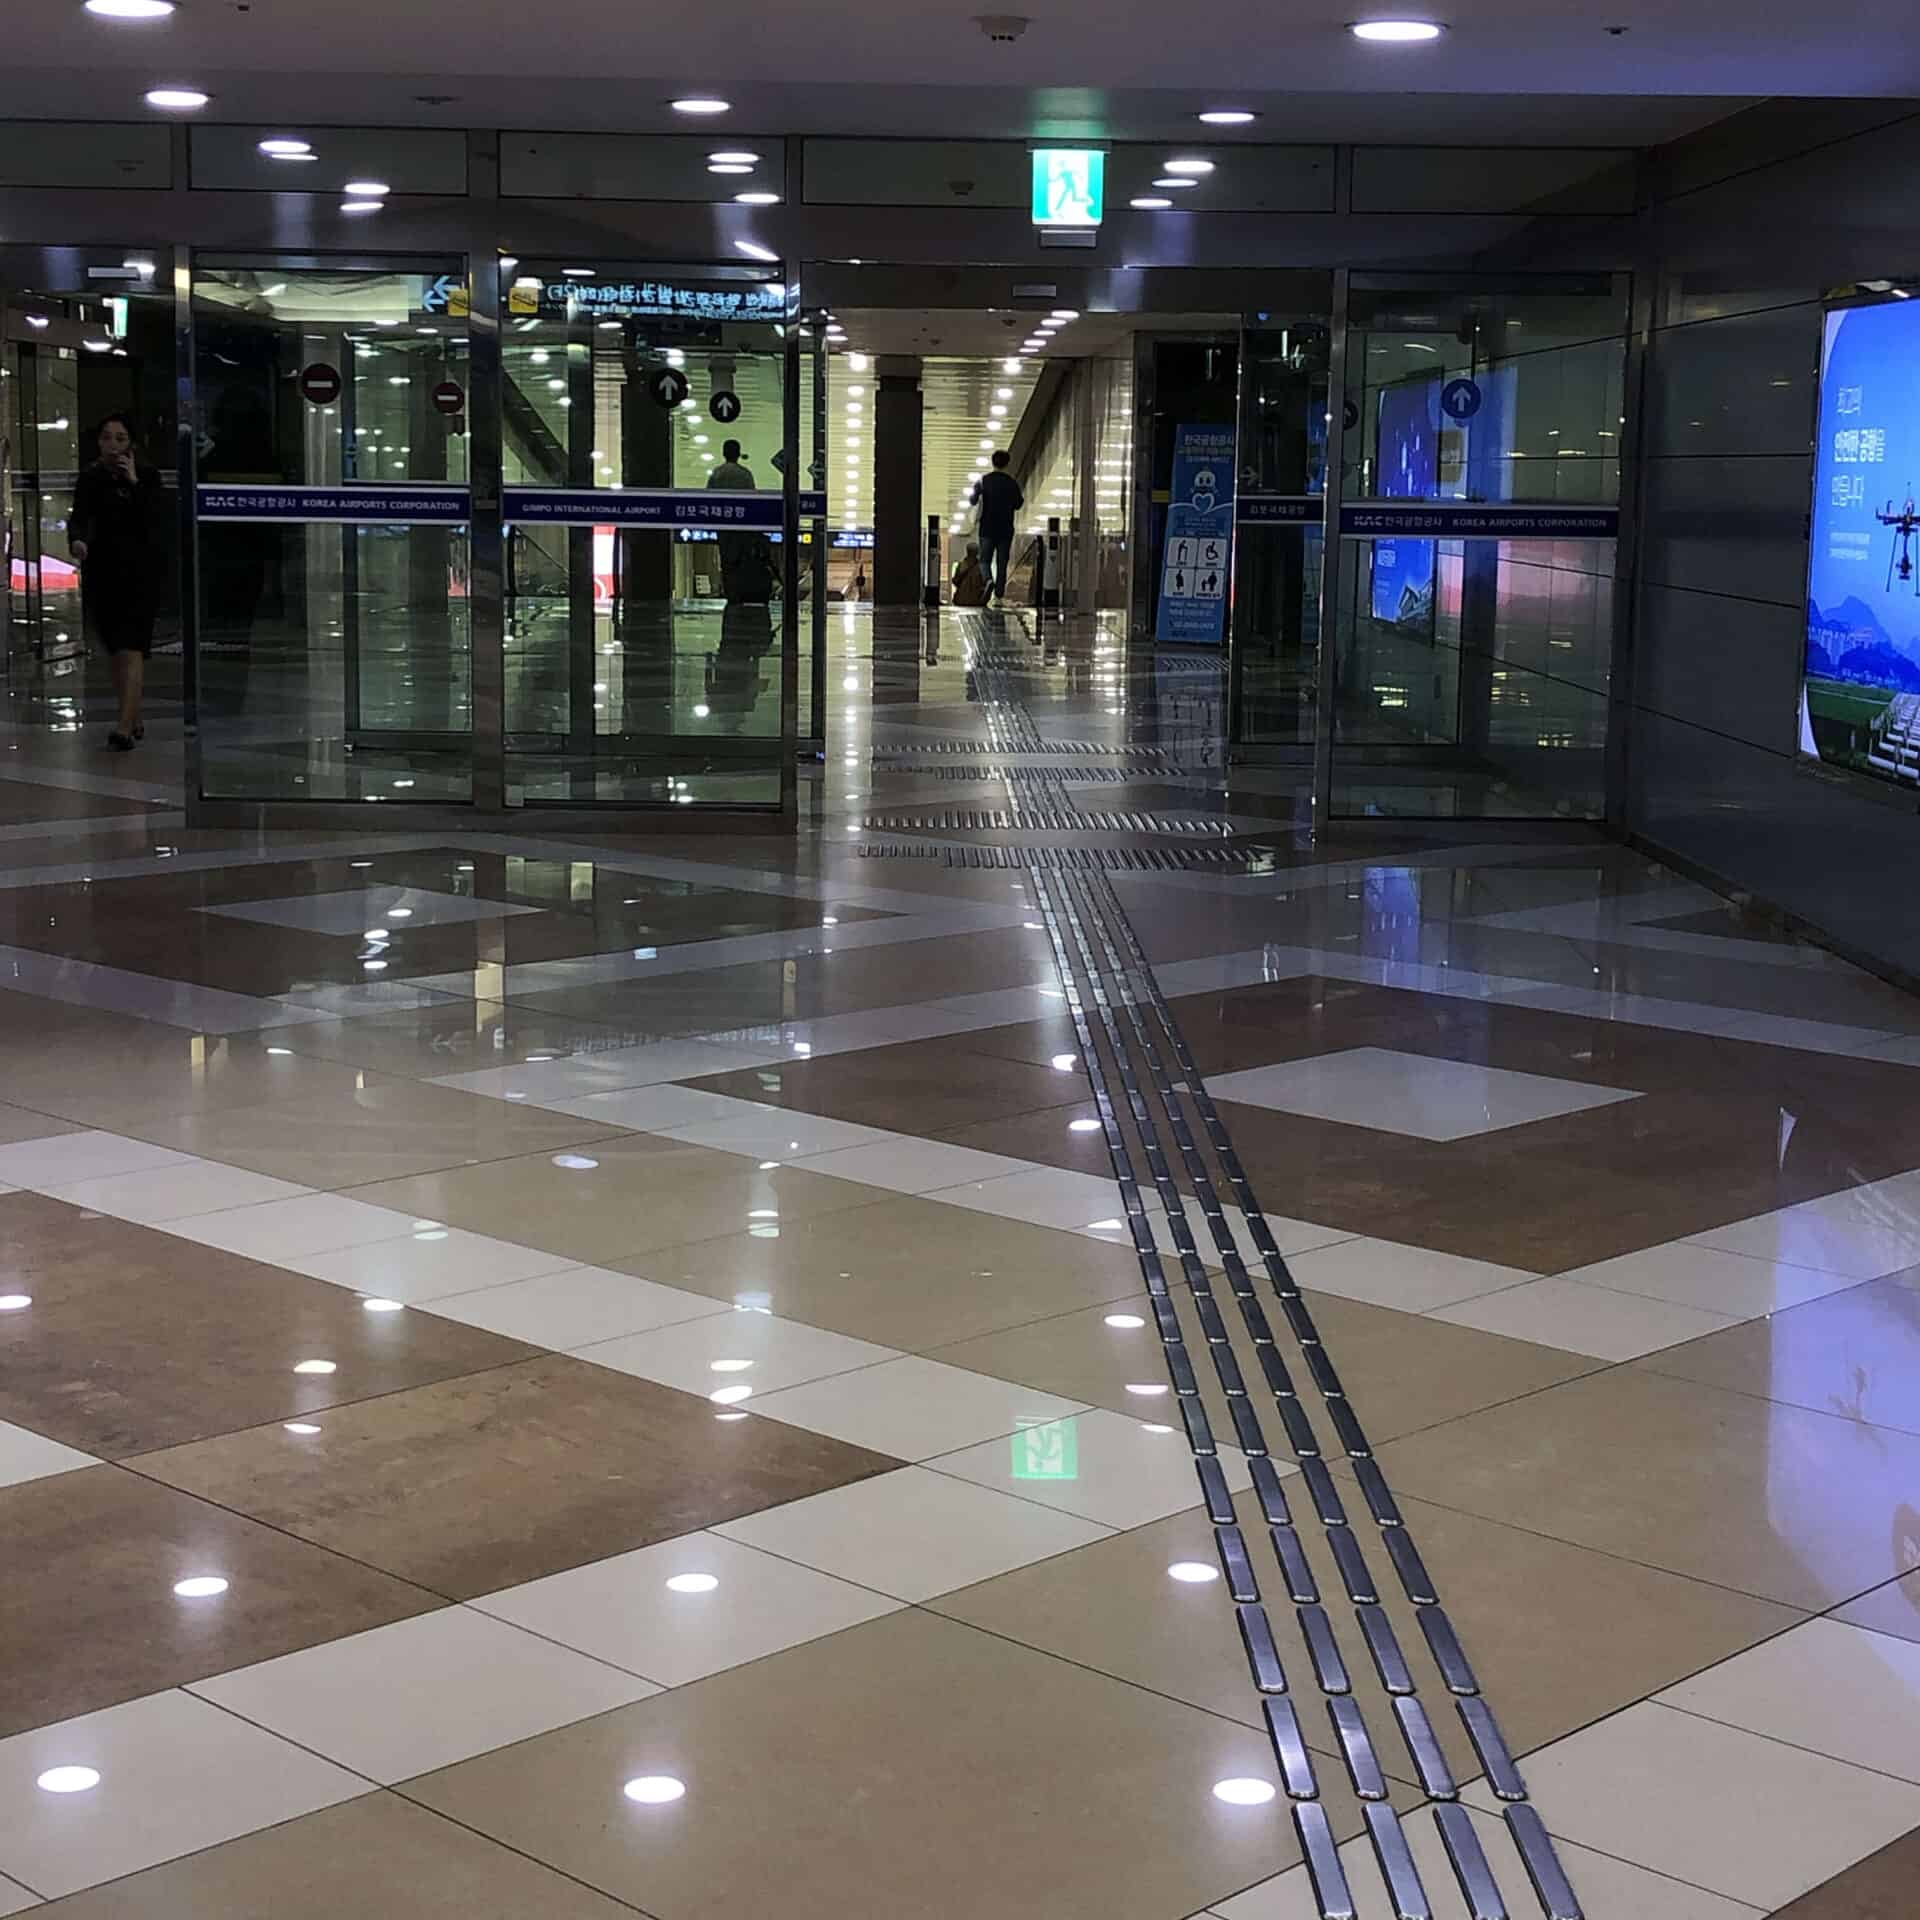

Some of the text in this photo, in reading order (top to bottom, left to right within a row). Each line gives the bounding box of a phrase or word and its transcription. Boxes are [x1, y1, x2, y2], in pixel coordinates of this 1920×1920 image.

[237, 496, 296, 509] 한국공항공사
[302, 499, 337, 509] KOREA
[339, 500, 387, 510] AIRPORTS
[389, 501, 460, 511] CORPORATION
[521, 503, 746, 519] GIMPO INTERNATIONAL AIRPORT 김포국제공항
[1452, 517, 1487, 527] KOREA
[1488, 517, 1536, 528] AIRPORTS
[1537, 518, 1608, 529] CORPORATION
